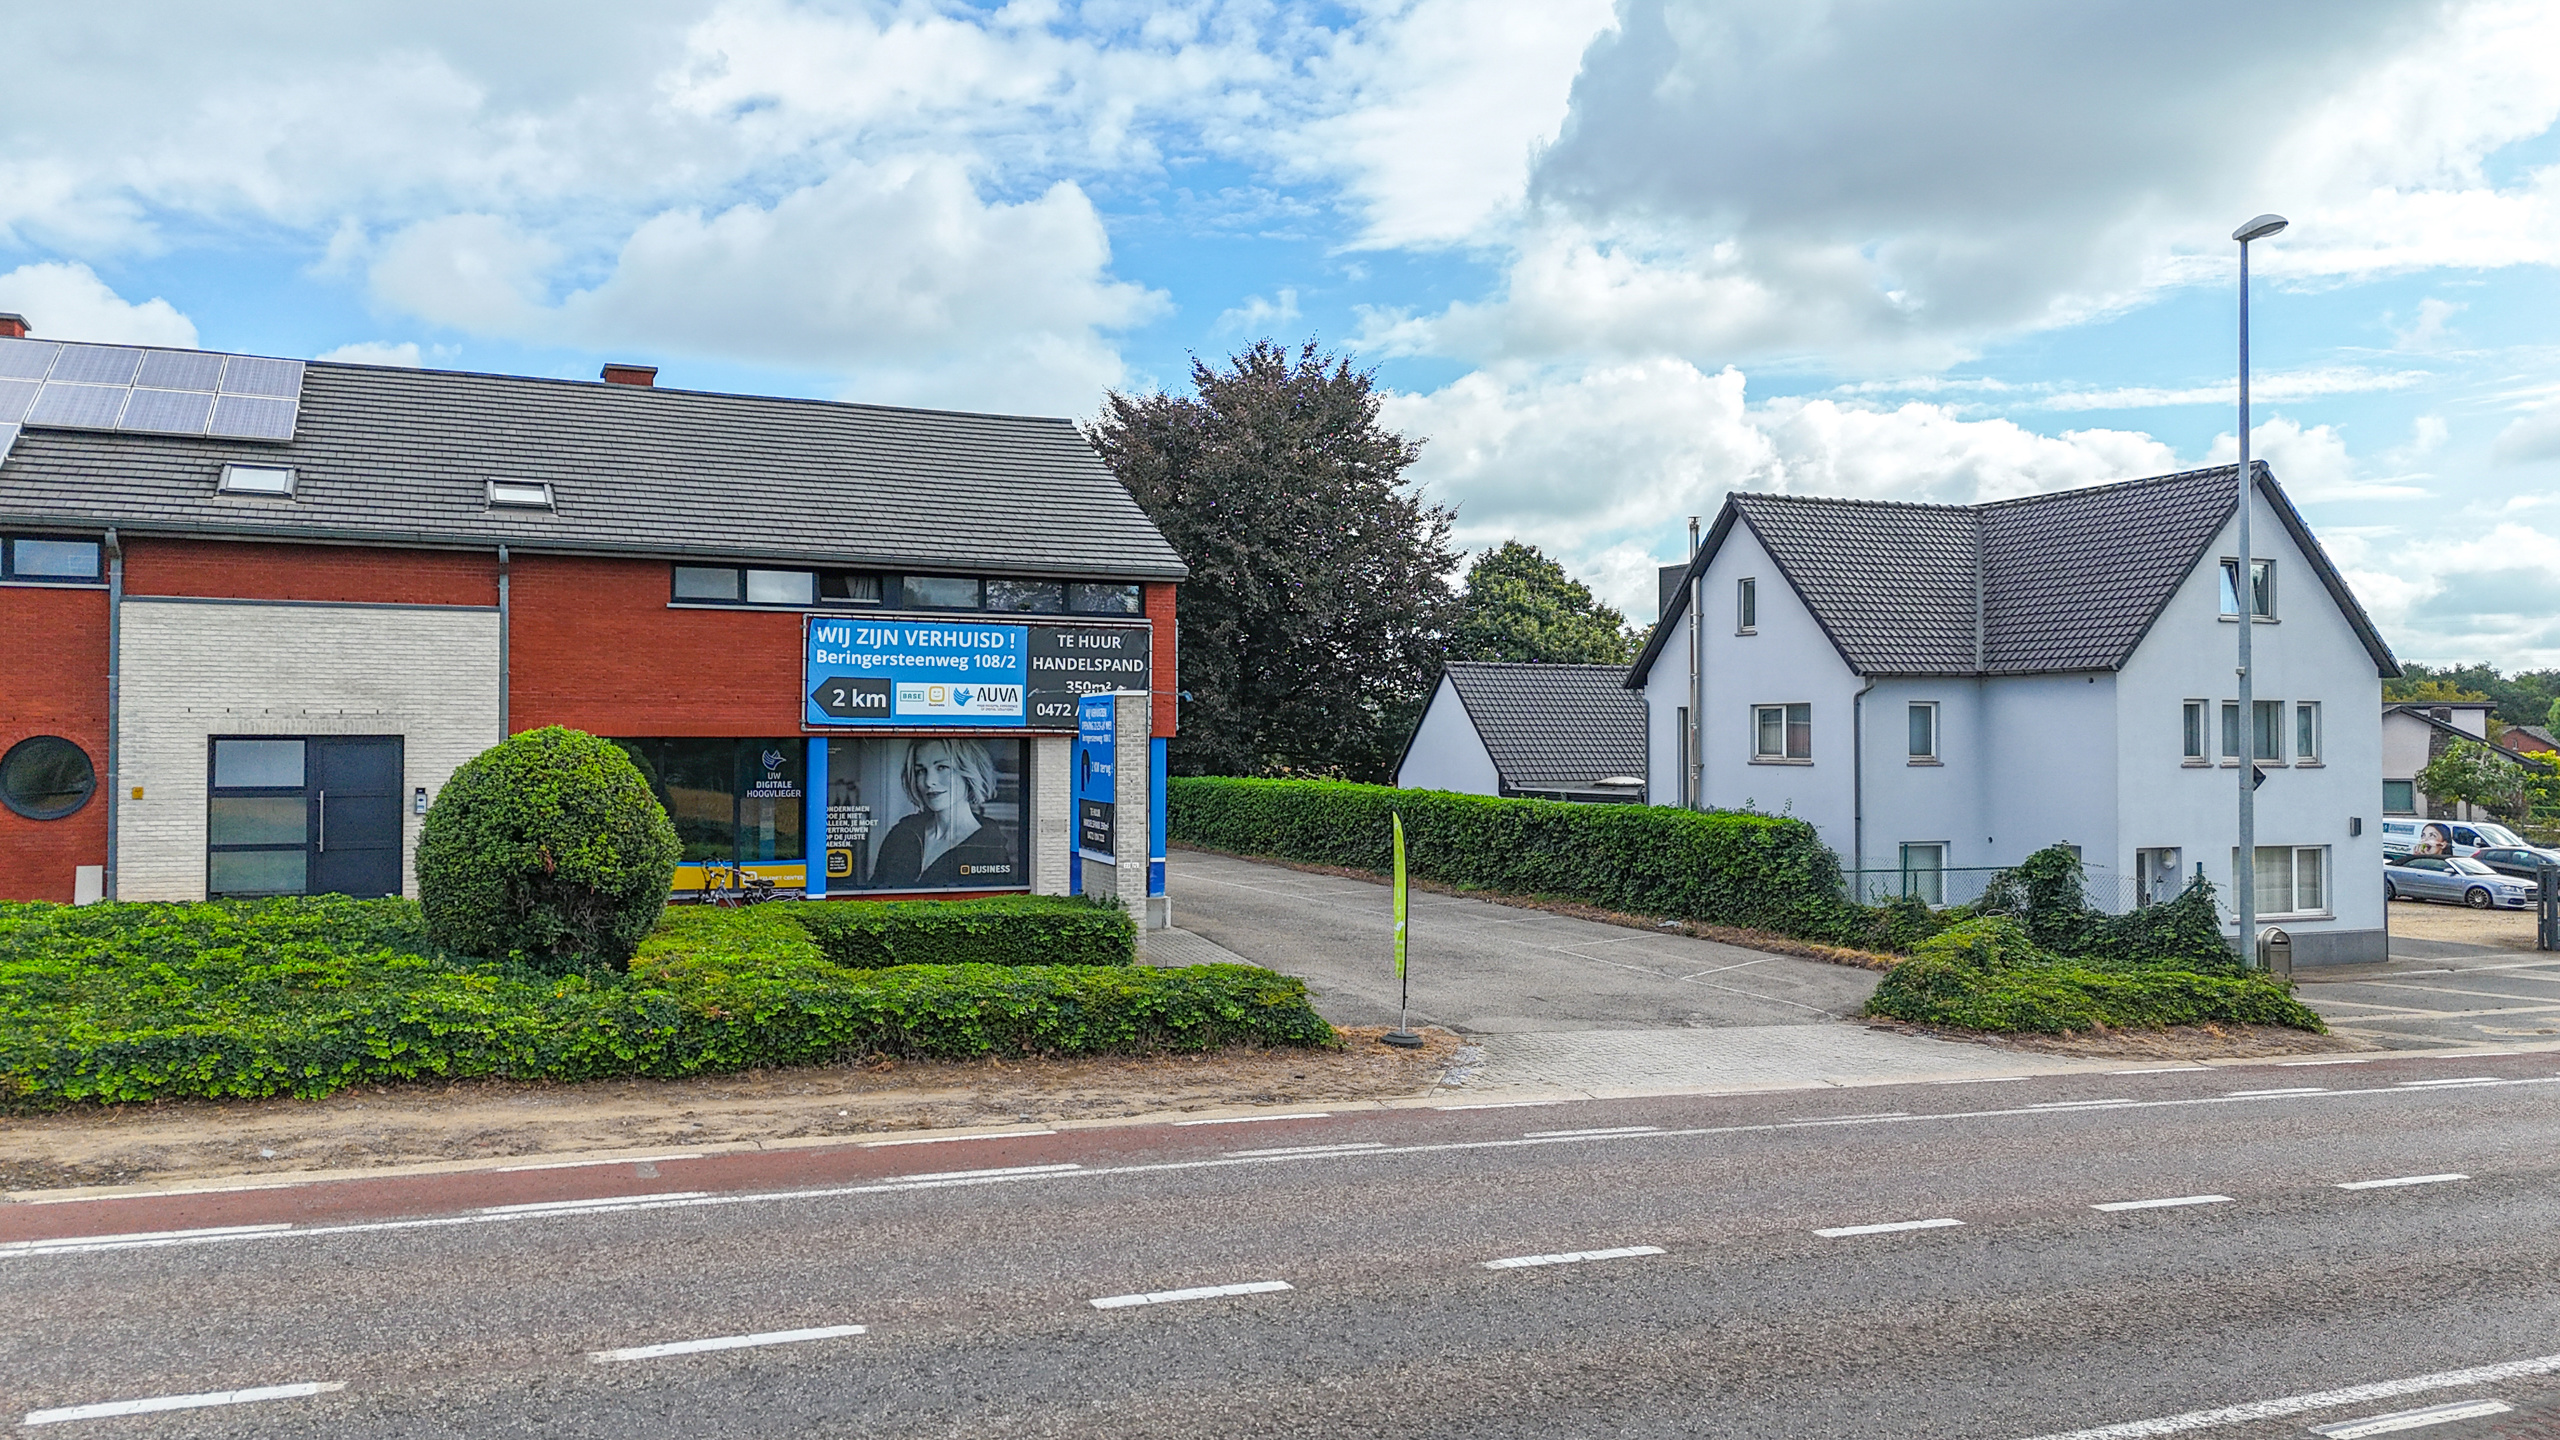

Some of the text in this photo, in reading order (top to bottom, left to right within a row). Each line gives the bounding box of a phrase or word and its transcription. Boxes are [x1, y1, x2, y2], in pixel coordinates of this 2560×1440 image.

[817, 627, 1015, 649] WIJ ZIJN VERHUISD !
[1057, 634, 1122, 649] TE HUUR
[816, 649, 1016, 671] Beringersteenweg 108/2
[1032, 656, 1144, 672] HANDELSPAND
[832, 688, 887, 708] 2 km
[976, 687, 1018, 702] AUVA
[1036, 703, 1071, 717] 0472
[767, 772, 781, 780] UW
[755, 781, 792, 789] DIGITALE
[746, 789, 802, 798] HOOGVLIEGER
[970, 865, 1011, 874] BUSINESS
